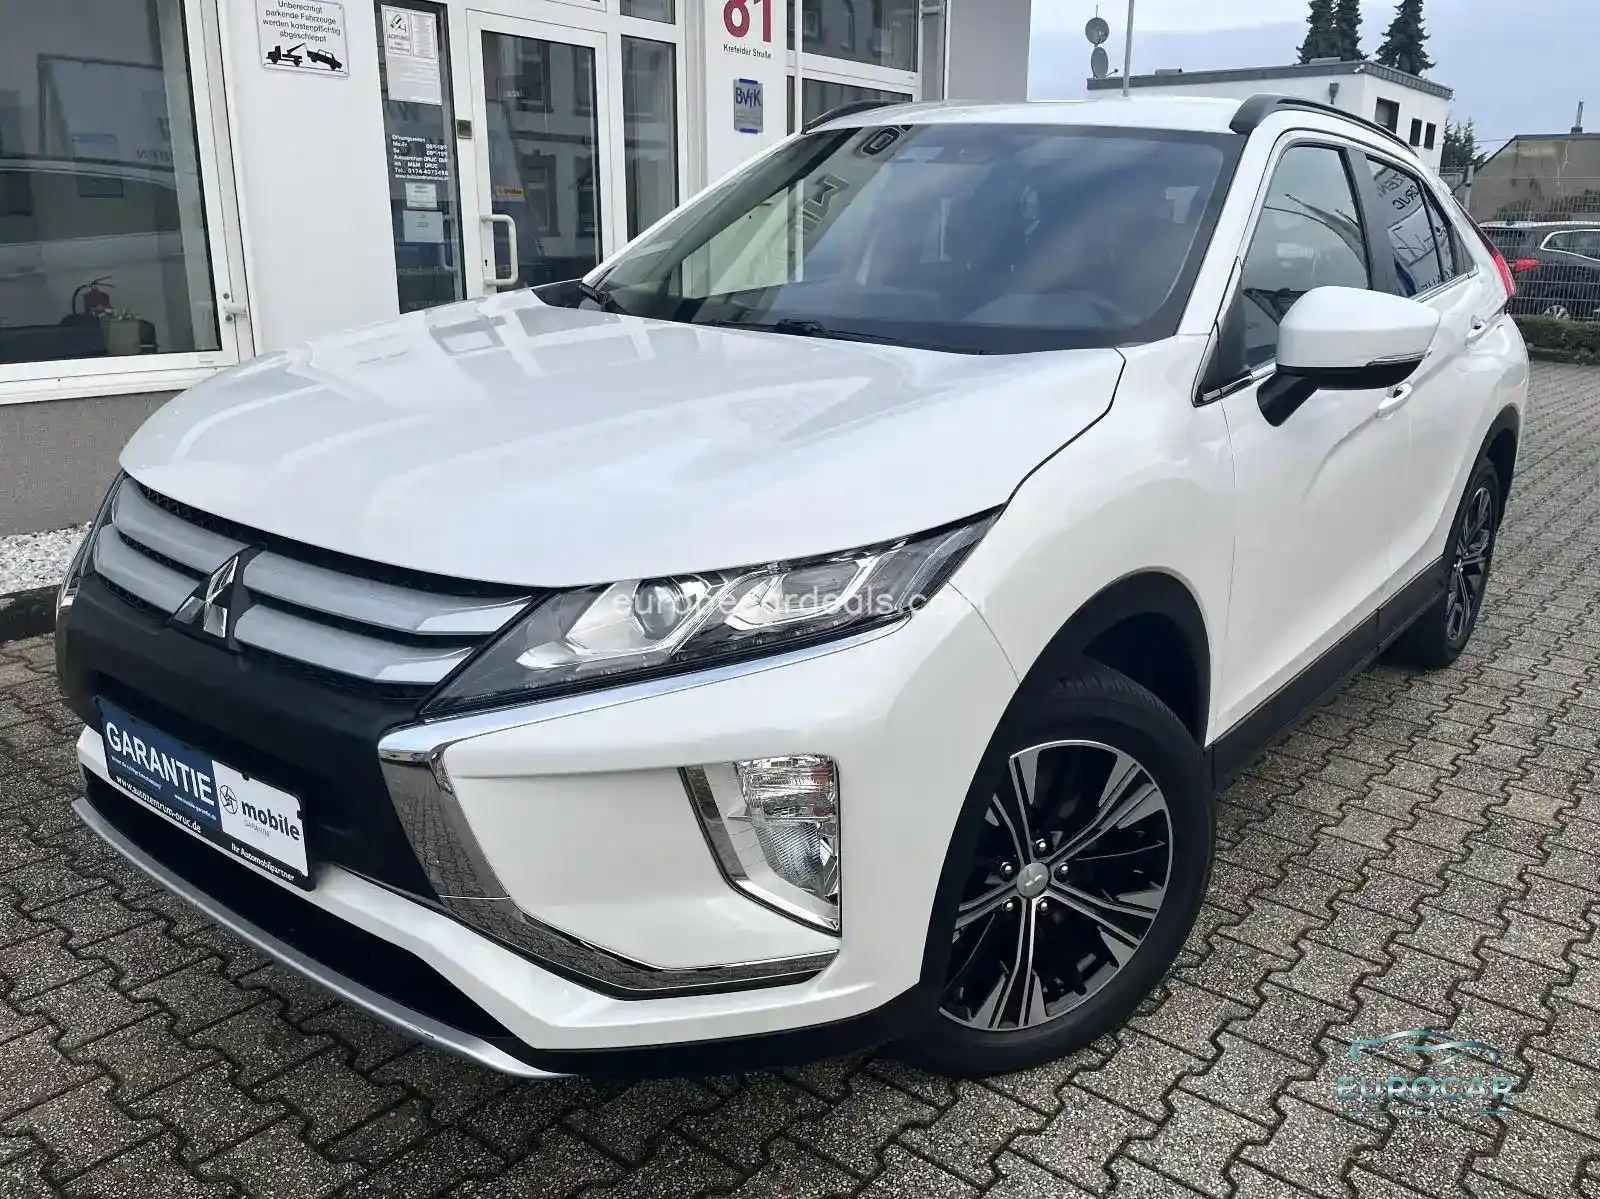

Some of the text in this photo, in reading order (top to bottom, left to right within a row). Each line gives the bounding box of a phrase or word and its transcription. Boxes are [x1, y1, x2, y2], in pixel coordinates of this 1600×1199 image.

[278, 0, 322, 14] Unberechtigt
[265, 9, 336, 25] parkende Fahrzeuge
[263, 19, 341, 36] werden kostenpflichtig
[280, 30, 327, 42] abgeschleppt
[724, 43, 772, 59] Krefelder Straße
[105, 721, 214, 806] GARANTIE
[116, 775, 202, 833] www.autozentrum-oruc.de
[241, 800, 300, 840] mobile
[231, 842, 295, 882] Ihr Automobilpartner
